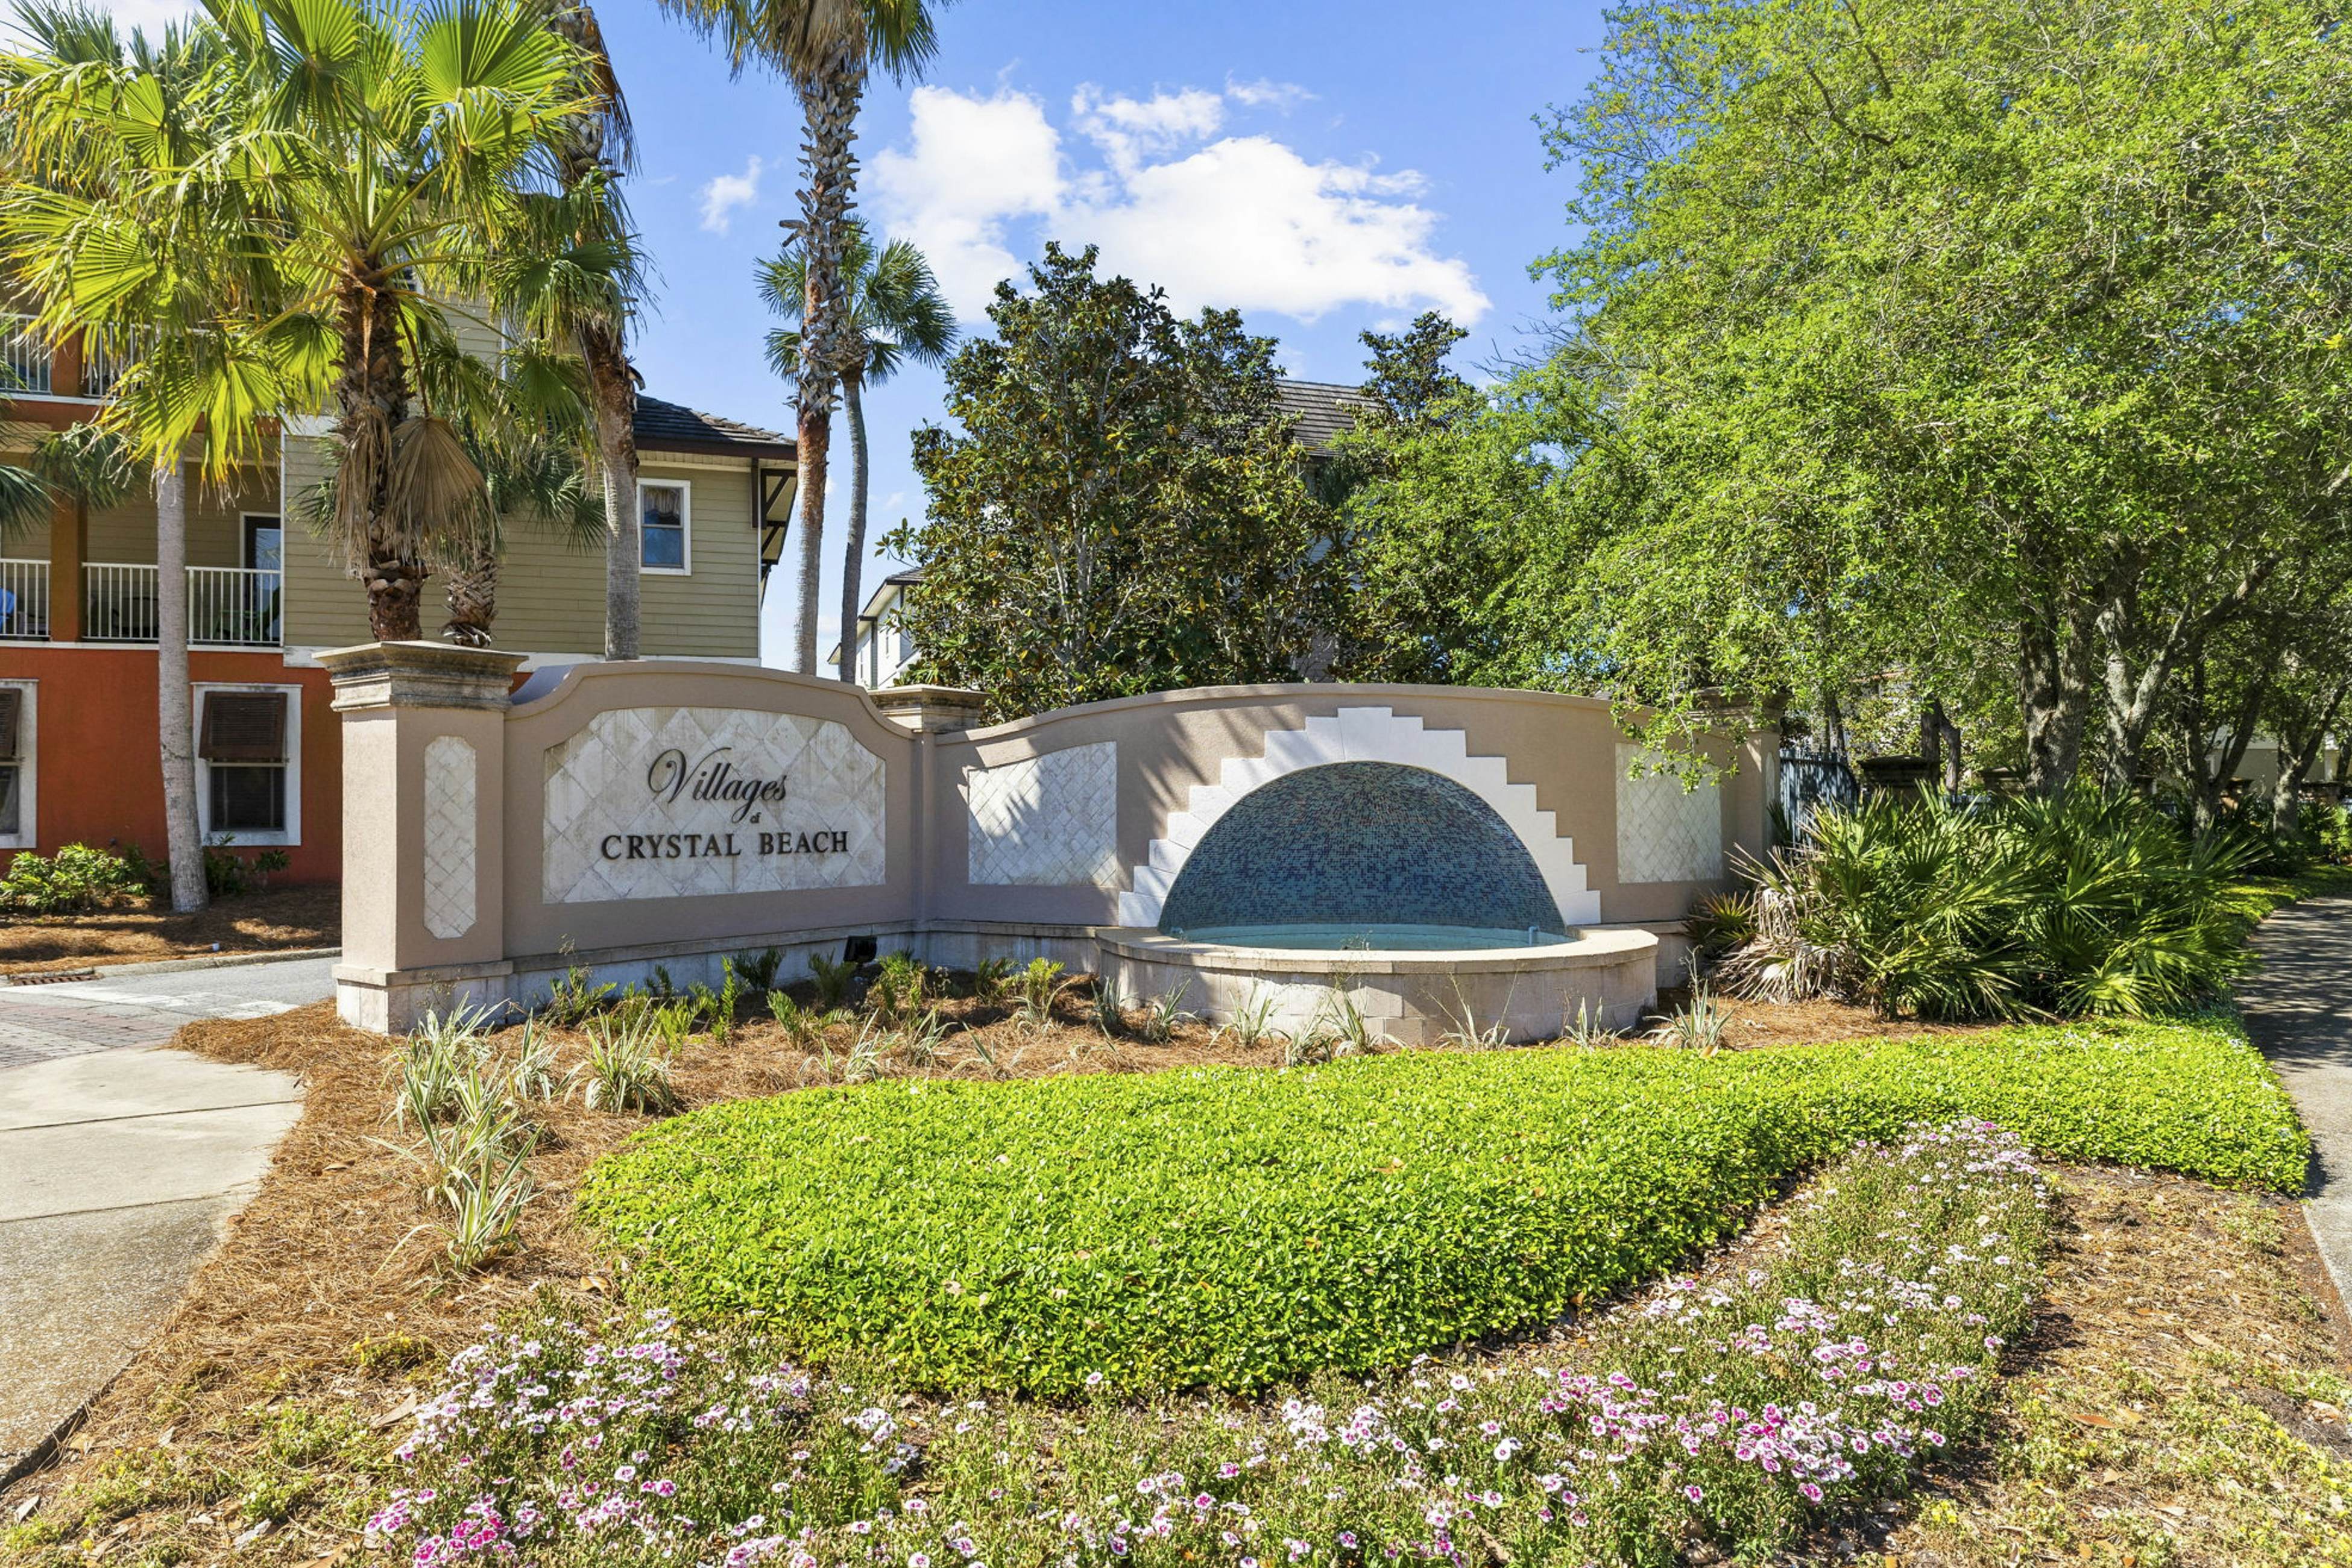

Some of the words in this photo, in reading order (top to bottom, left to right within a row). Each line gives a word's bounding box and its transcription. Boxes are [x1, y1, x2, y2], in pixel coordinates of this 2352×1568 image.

[648, 748, 786, 824] Villages
[750, 812, 760, 823] of
[602, 833, 741, 860] CRYSTAL
[759, 831, 849, 855] BEACH
